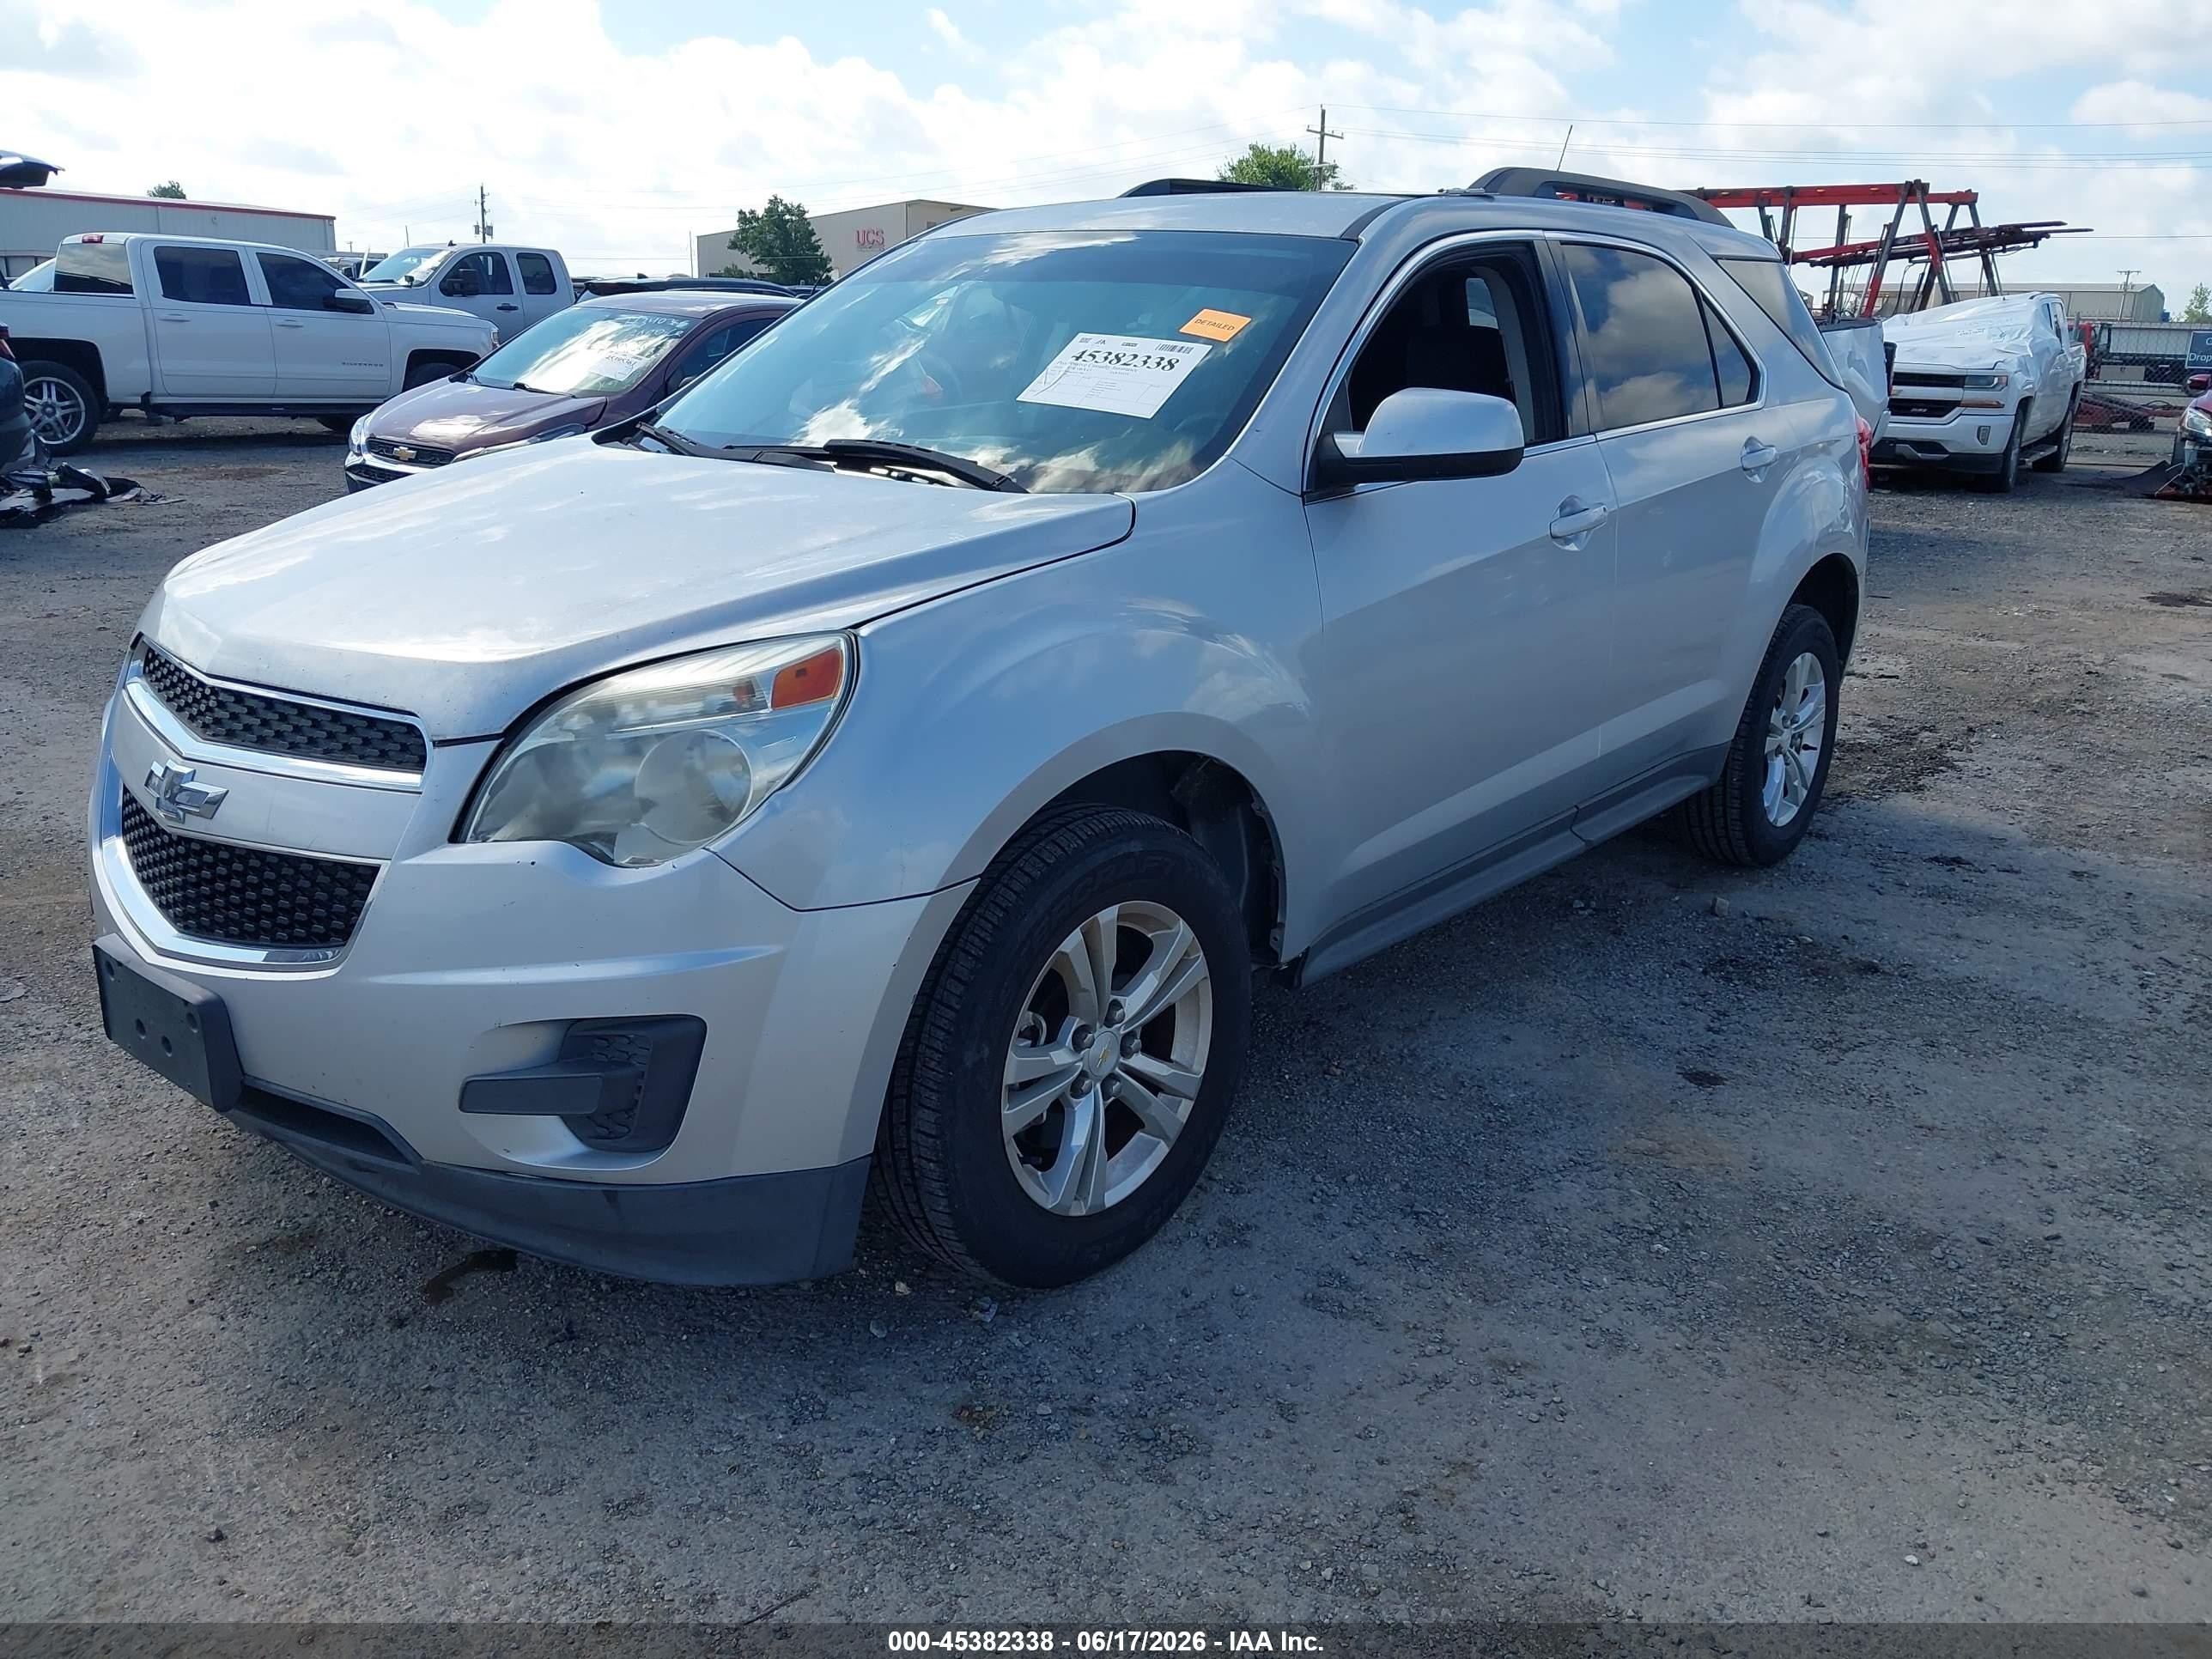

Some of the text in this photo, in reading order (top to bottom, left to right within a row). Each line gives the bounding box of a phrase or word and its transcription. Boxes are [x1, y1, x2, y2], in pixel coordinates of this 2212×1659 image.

[856, 228, 885, 246] UCS
[1194, 319, 1235, 331] DETAILED
[1071, 349, 1180, 372] 45382338
